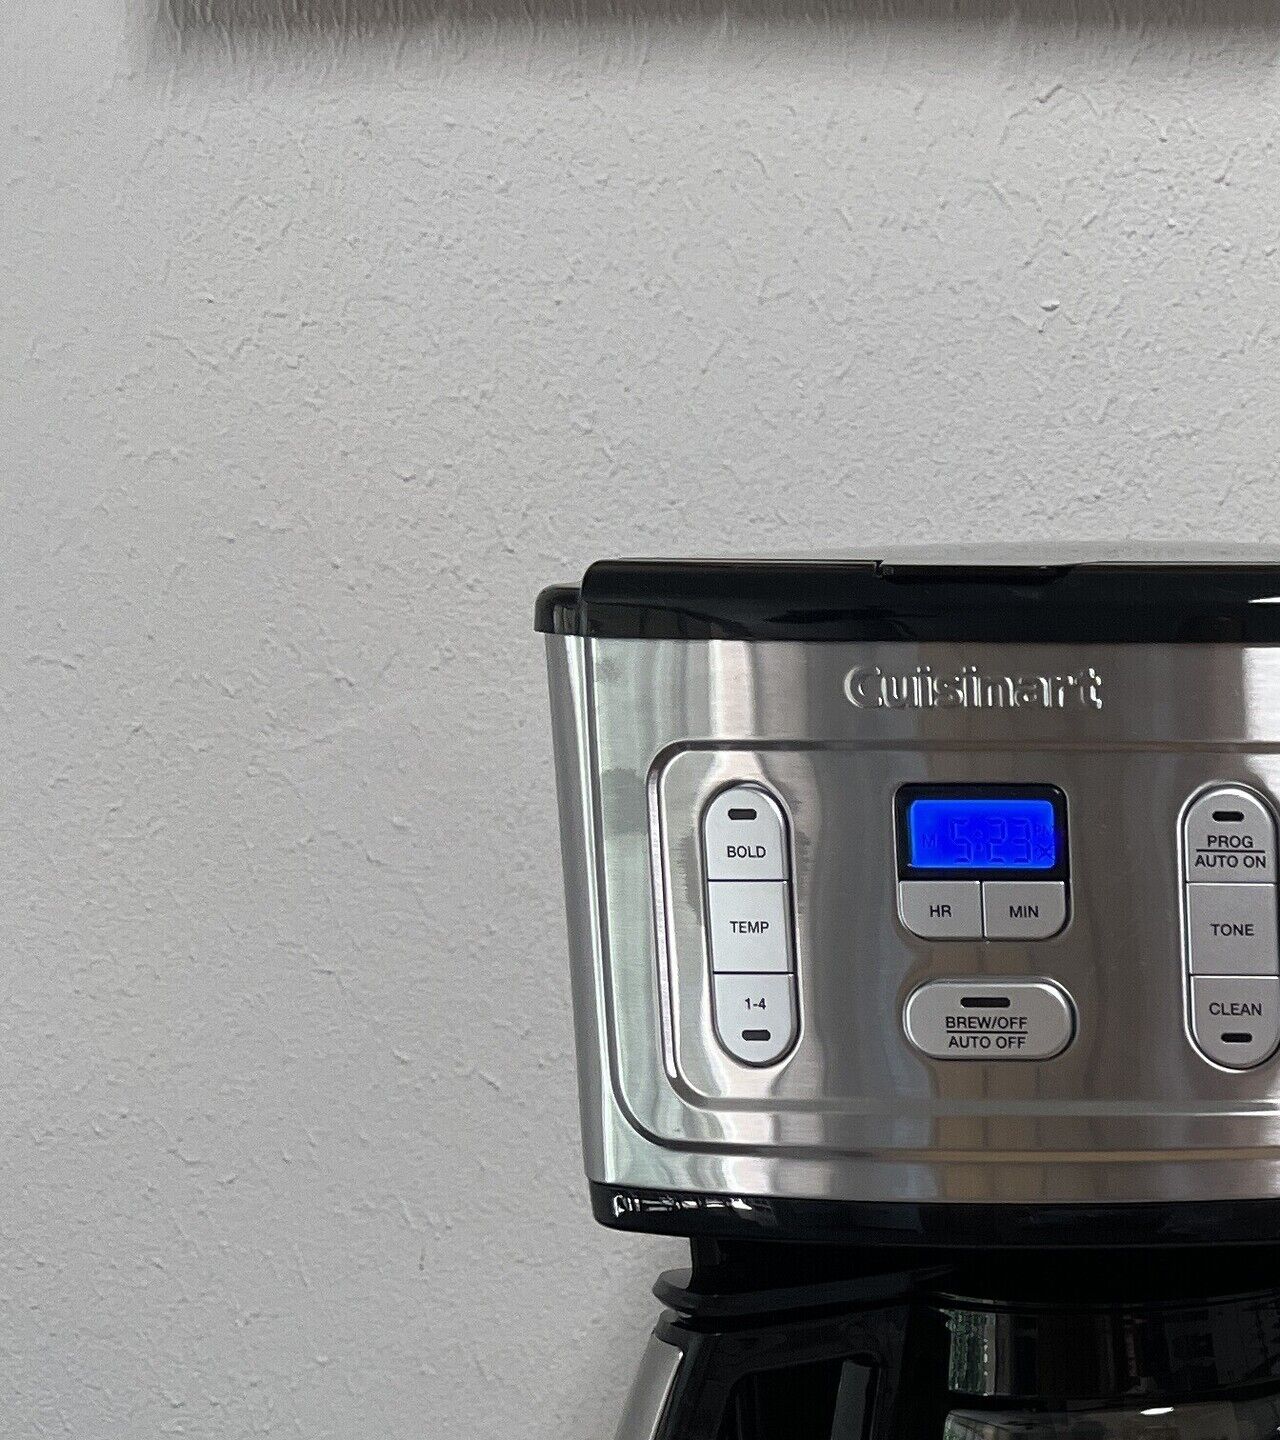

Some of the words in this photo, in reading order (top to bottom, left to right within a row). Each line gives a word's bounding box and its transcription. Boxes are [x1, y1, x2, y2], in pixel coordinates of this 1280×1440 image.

[843, 664, 1102, 709] Cuisinart
[1207, 835, 1254, 849] PROG
[727, 845, 767, 859] BOLD
[1194, 854, 1240, 868] AUTO
[1243, 855, 1267, 869] ON
[929, 904, 952, 918] HR
[1009, 905, 1040, 918] MIN
[729, 920, 770, 934] TEMP
[1210, 923, 1255, 937] TONE
[744, 997, 767, 1011] 1-4
[1209, 1002, 1263, 1016] CLEAN
[945, 1016, 1028, 1030] BREW/OFF
[948, 1035, 991, 1049] AUTO
[995, 1036, 1027, 1049] OFF
